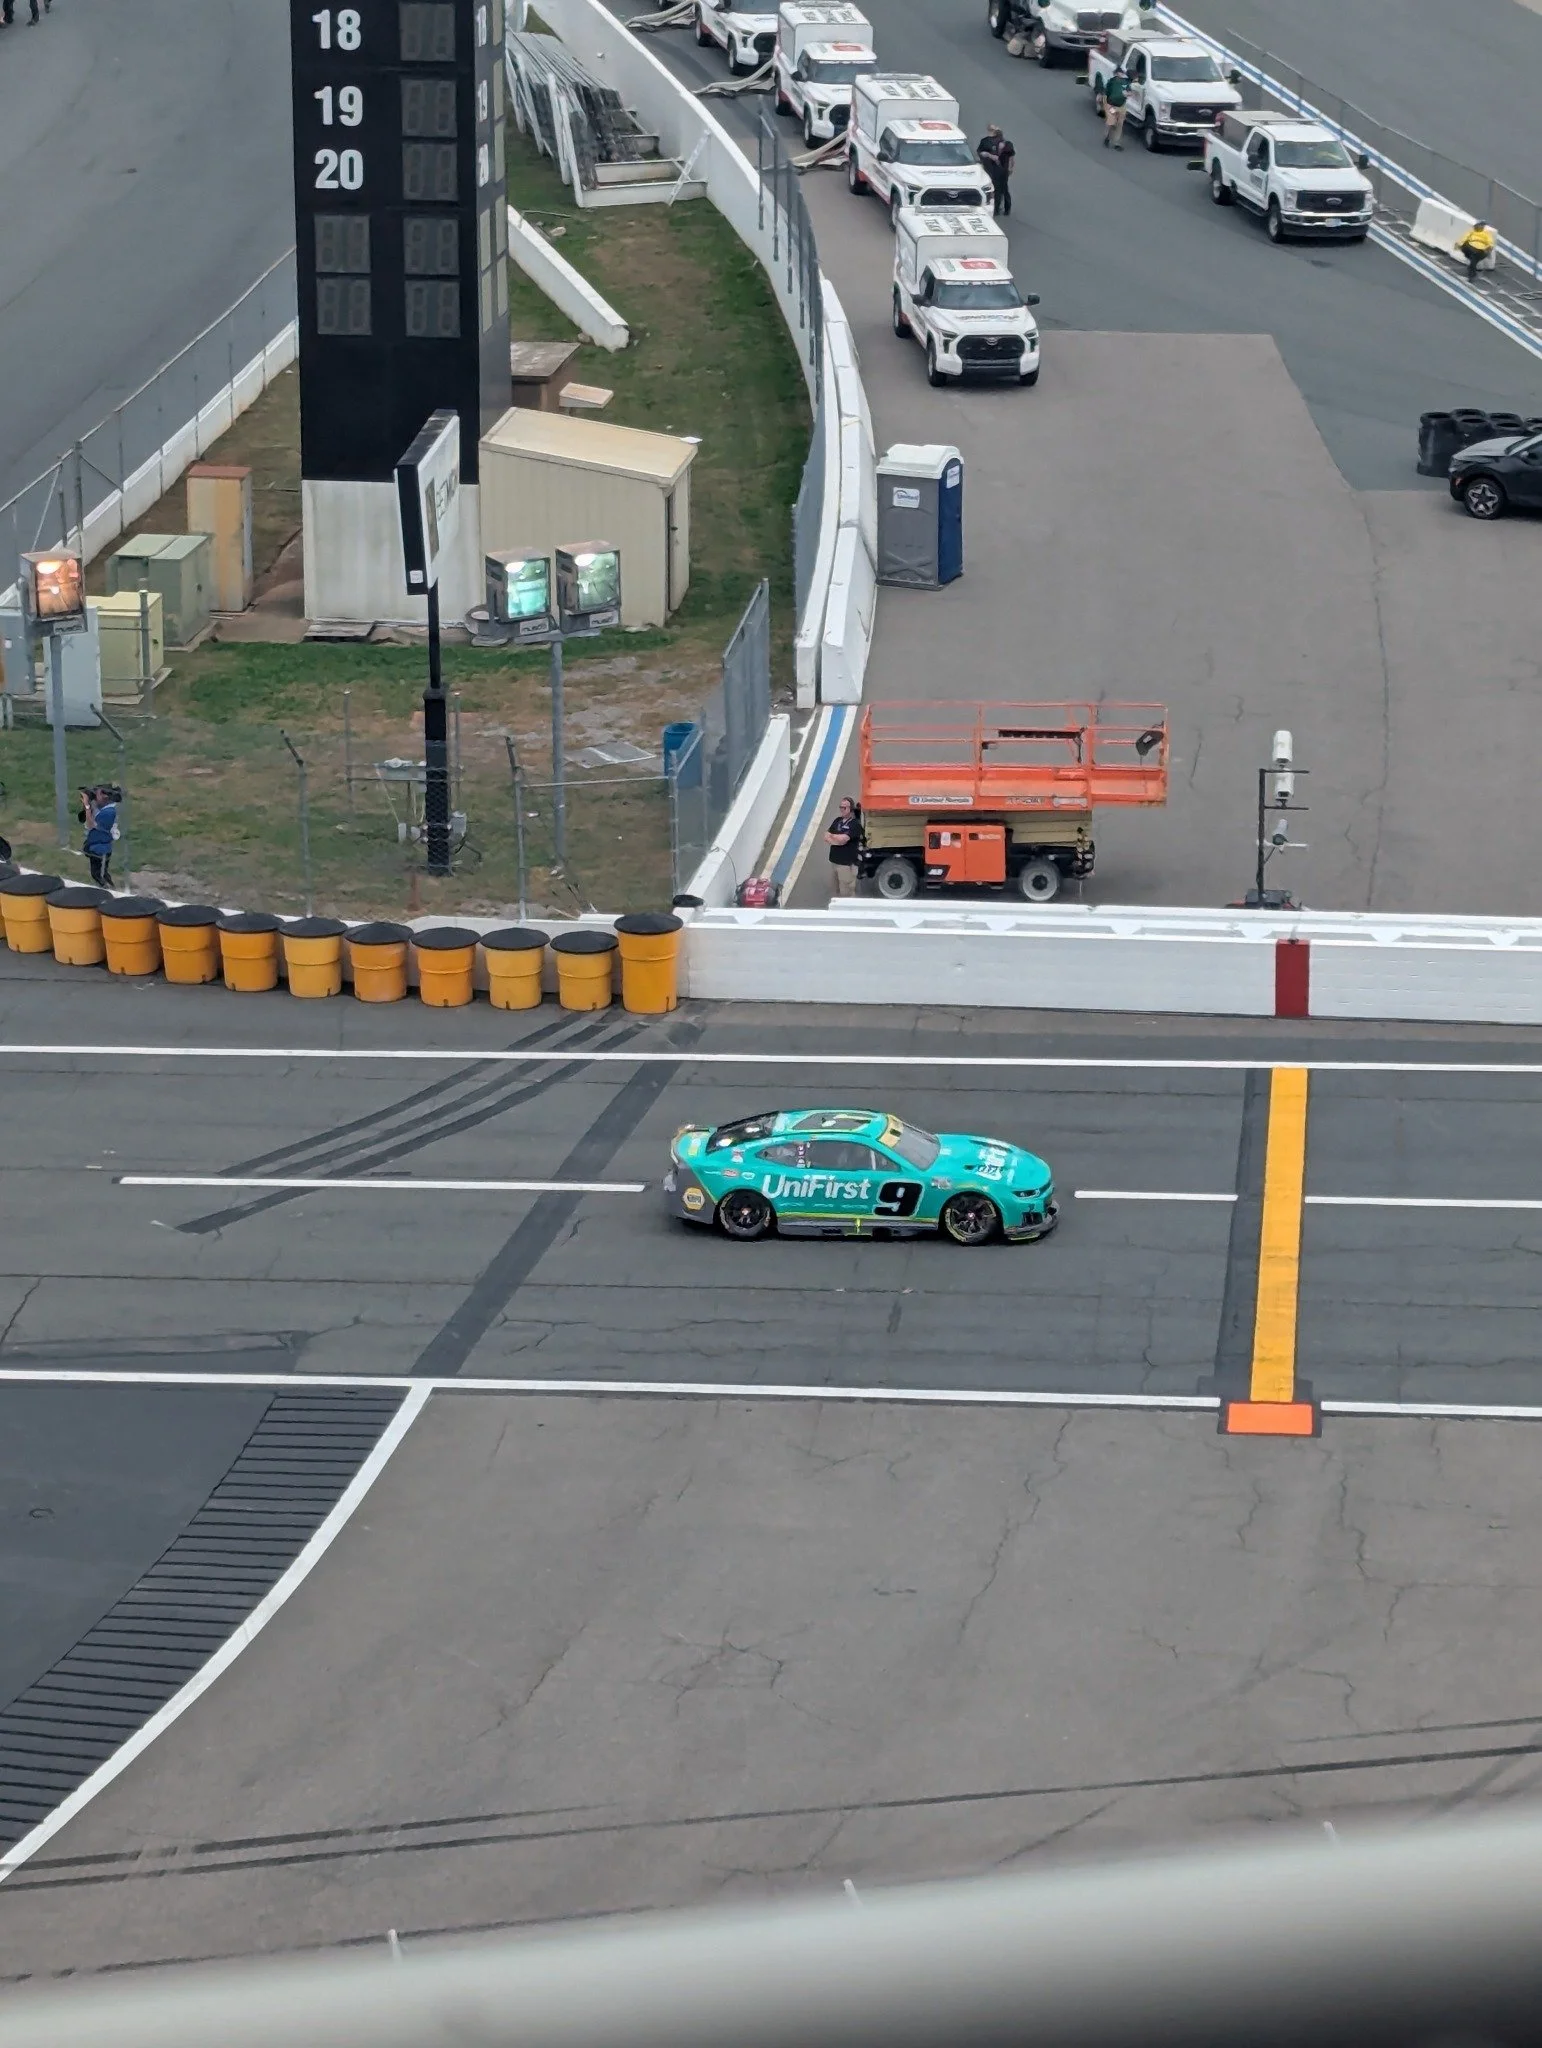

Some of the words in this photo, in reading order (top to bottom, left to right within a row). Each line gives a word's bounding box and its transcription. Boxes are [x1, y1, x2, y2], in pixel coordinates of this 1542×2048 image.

[312, 8, 362, 51] 18
[313, 85, 363, 127] 19
[313, 148, 364, 191] 20
[761, 1173, 871, 1200] UniFirst
[872, 1180, 925, 1218] 9
